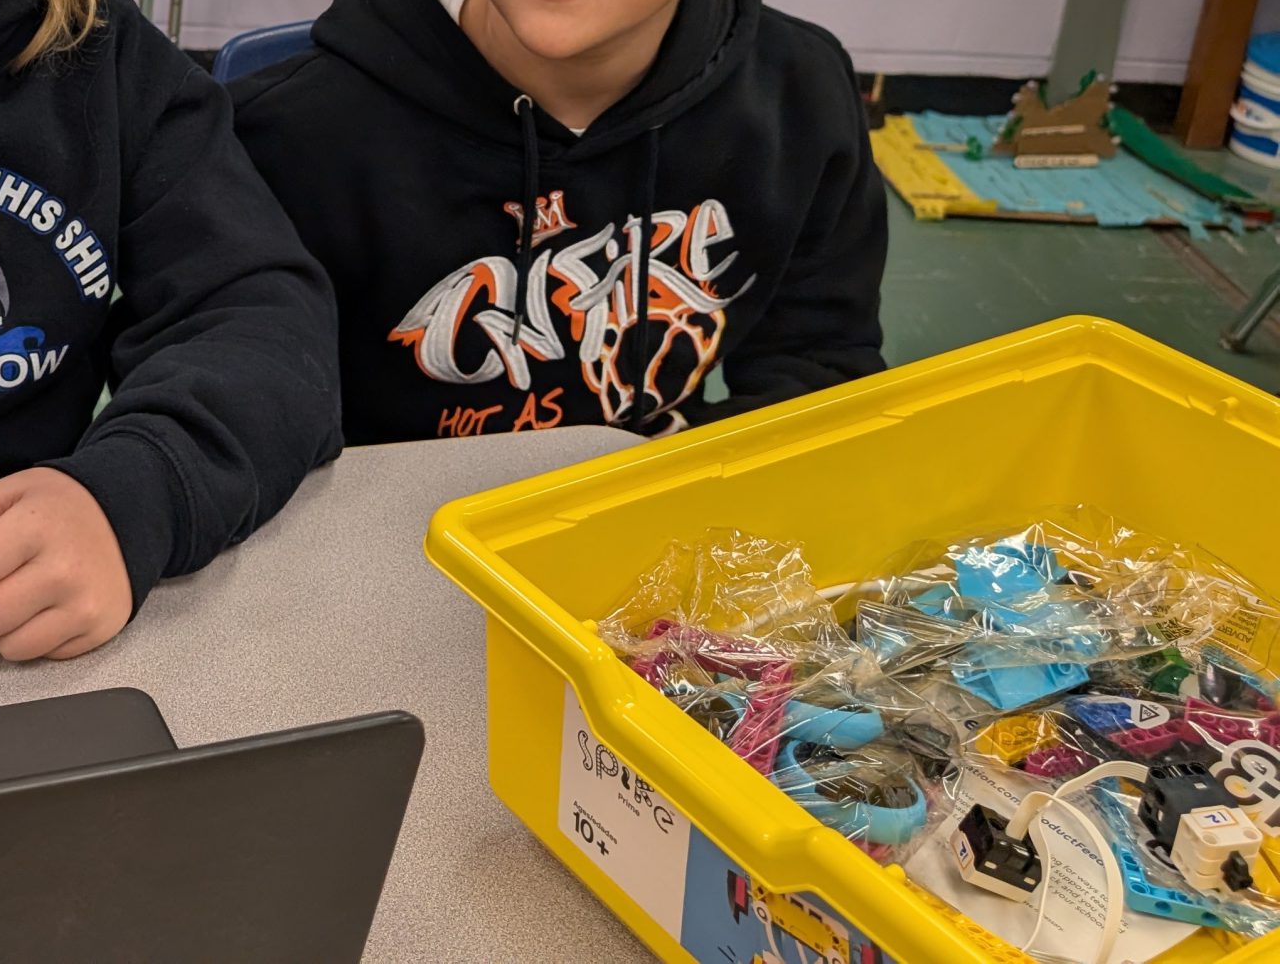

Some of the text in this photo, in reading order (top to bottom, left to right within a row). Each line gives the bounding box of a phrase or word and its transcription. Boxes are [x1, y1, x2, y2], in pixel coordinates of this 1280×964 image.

[55, 219, 112, 299] SHIP
[437, 387, 565, 437] HOT AS
[617, 793, 641, 817] Prime
[573, 800, 618, 845] Ages/edades
[1054, 870, 1090, 896] support
[1077, 876, 1099, 895] ways
[1052, 890, 1075, 906] your
[1061, 885, 1098, 913] and you
